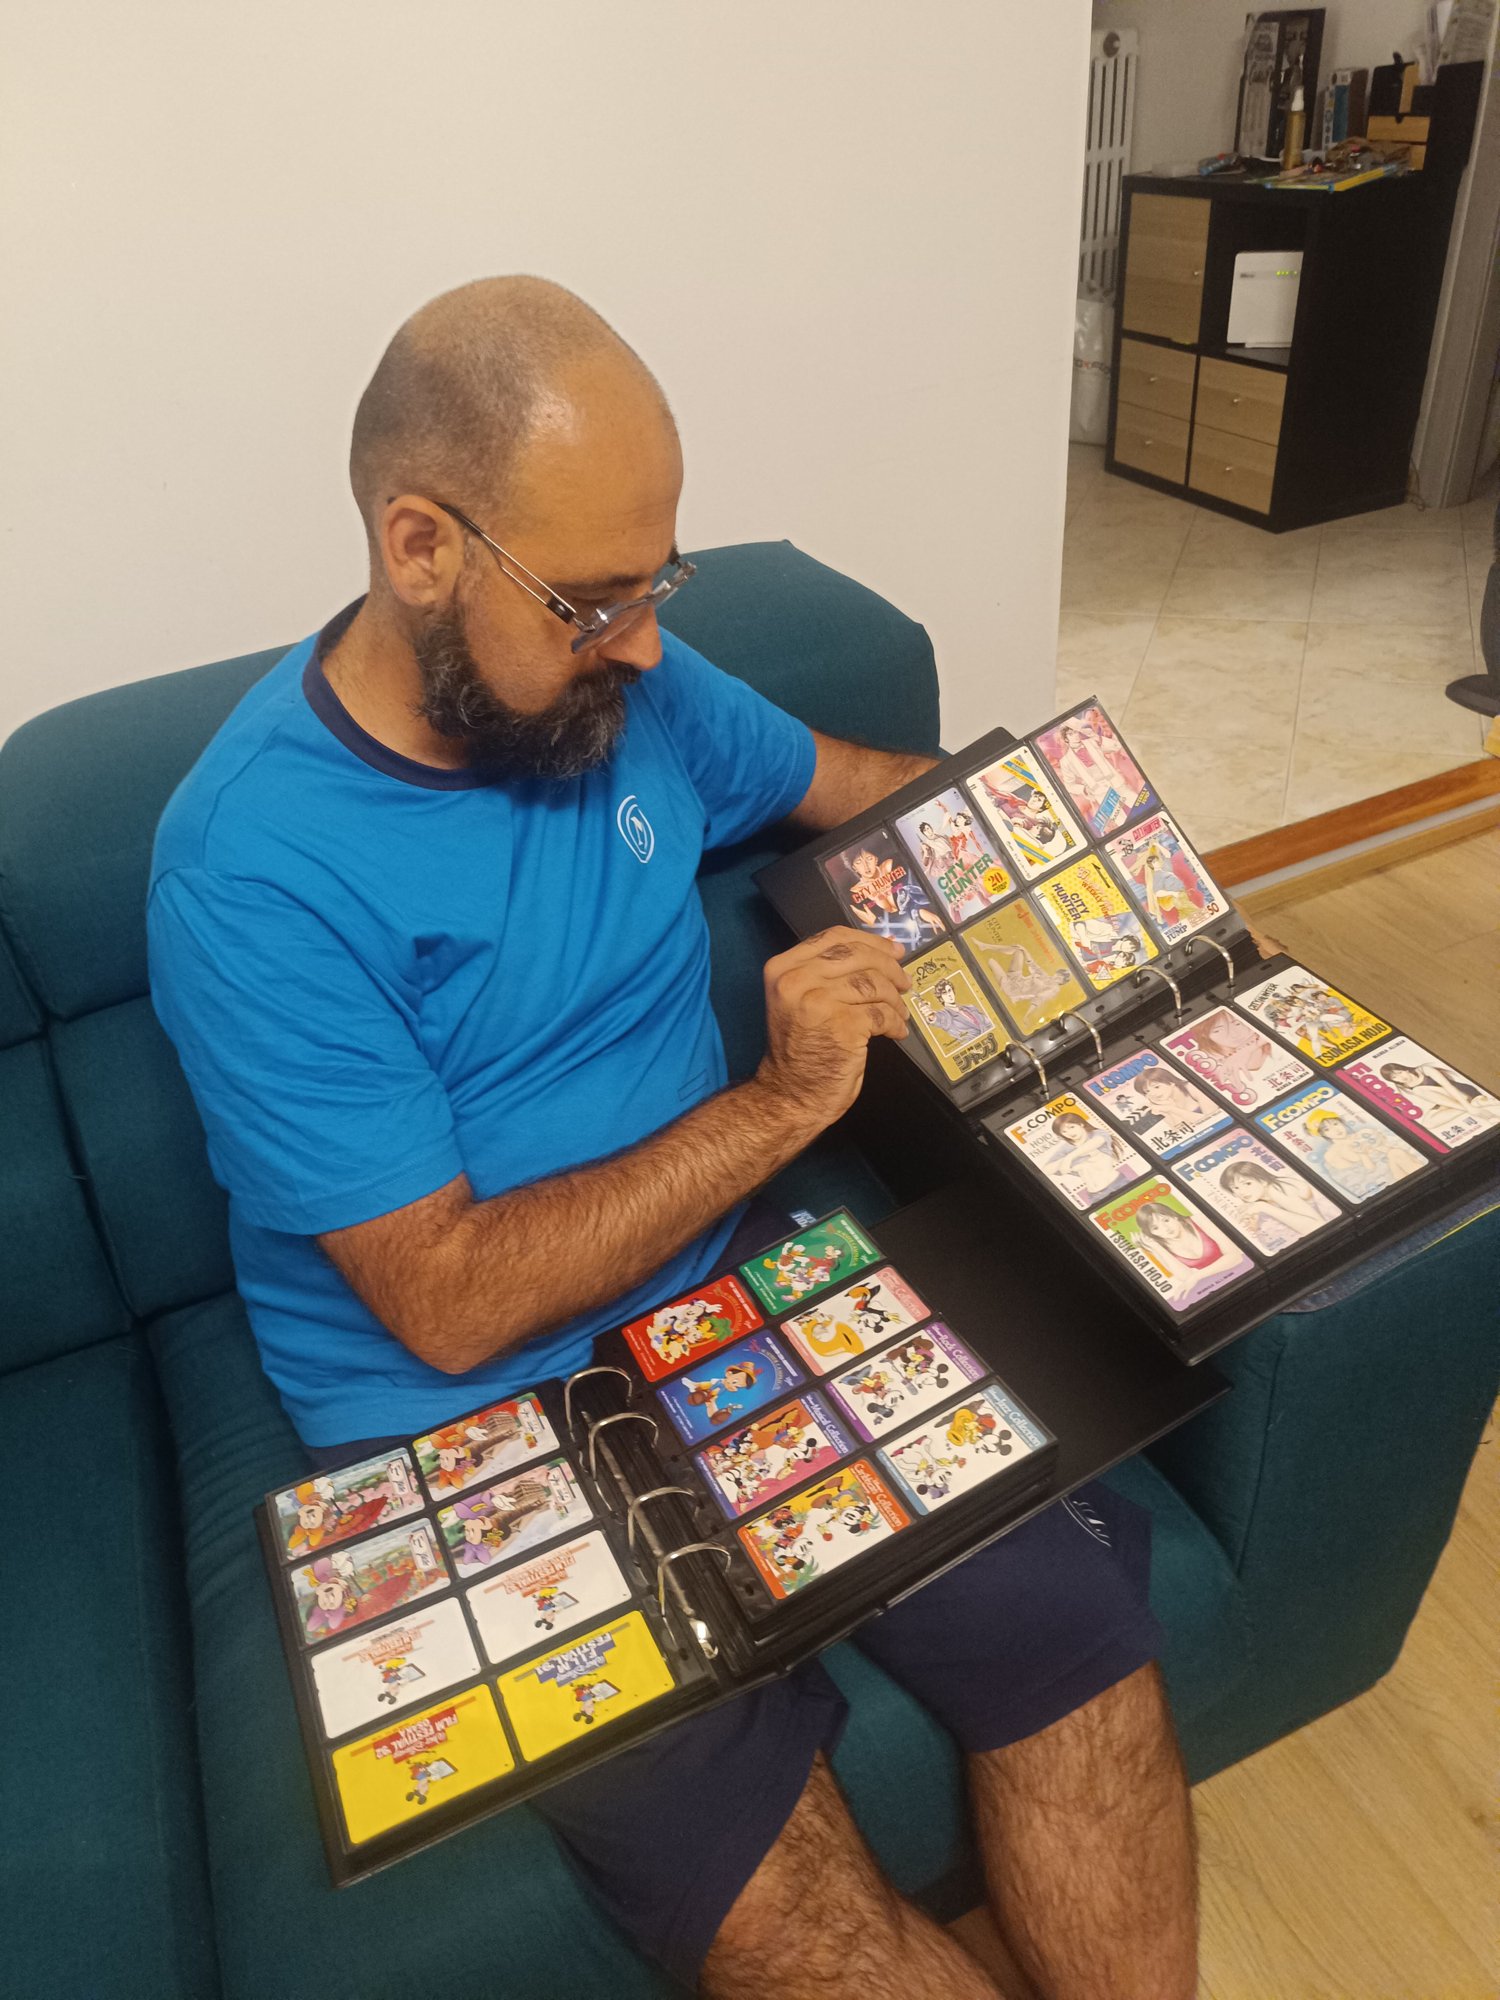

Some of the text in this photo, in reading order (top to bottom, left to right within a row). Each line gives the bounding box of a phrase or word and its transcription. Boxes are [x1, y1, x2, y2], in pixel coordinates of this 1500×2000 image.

[871, 866, 907, 891] HUNTER
[938, 858, 968, 890] CITY
[943, 853, 994, 904] HUNTER
[1051, 883, 1083, 921] HUNTER
[1070, 892, 1090, 914] CITY
[1206, 902, 1220, 916] 50
[1167, 924, 1188, 942] JUMP
[1315, 1022, 1388, 1065] TSUKASA HOJO
[1267, 1063, 1306, 1090] 北条司
[1029, 1132, 1053, 1149] HOJO
[1150, 1120, 1195, 1151] 北条司
[1109, 1230, 1173, 1294] TSUKASA HOJO
[951, 1347, 981, 1378] Collection
[825, 1422, 849, 1455] Collection
[1008, 1410, 1042, 1447] Collection
[876, 1492, 903, 1527] Collection
[552, 1632, 612, 1666] FESTIVAL
[555, 1648, 597, 1673] FILM
